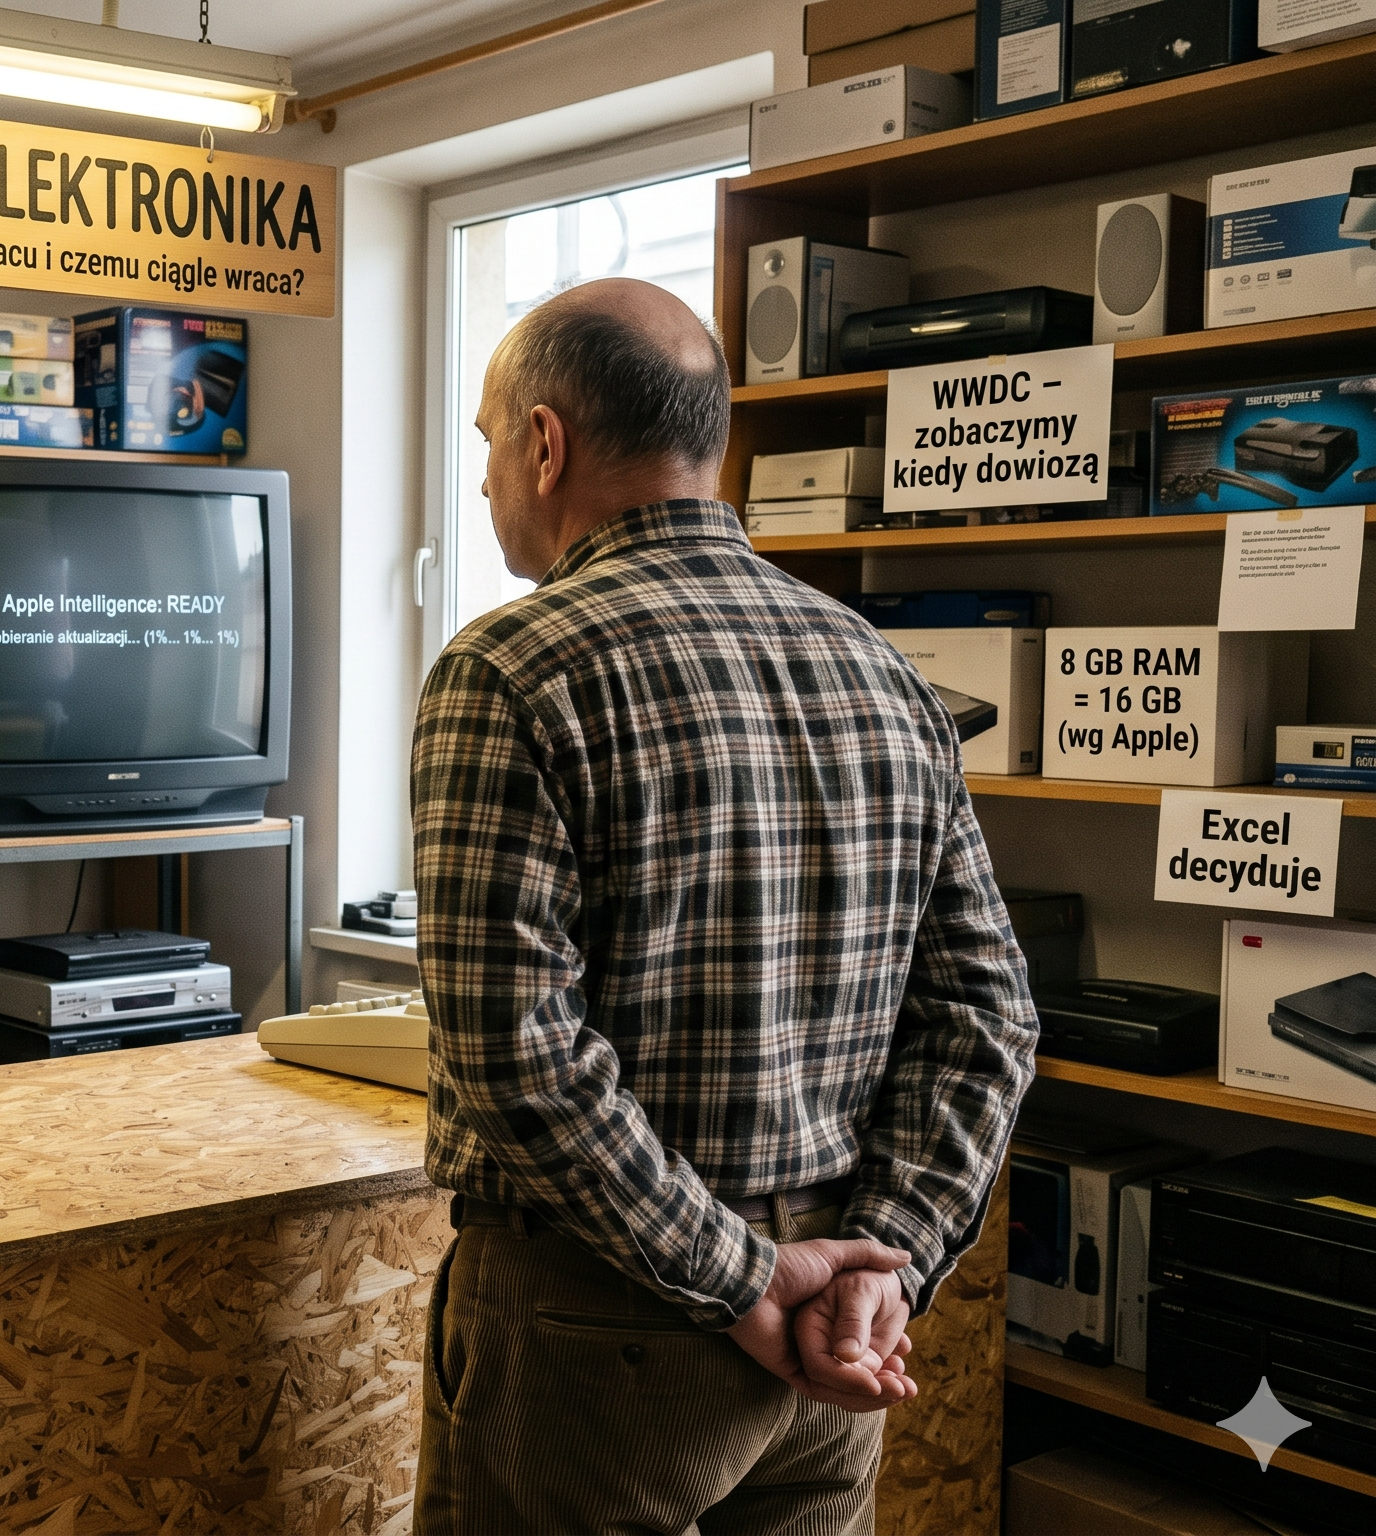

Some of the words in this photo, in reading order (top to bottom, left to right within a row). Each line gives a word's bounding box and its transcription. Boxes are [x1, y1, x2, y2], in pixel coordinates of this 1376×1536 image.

[45, 241, 52, 271] i
[60, 250, 139, 280] czemu
[147, 253, 218, 293] ciągle
[224, 268, 305, 297] wraca?
[932, 370, 1031, 410] WWDC
[914, 413, 1078, 450] zobaczymy
[893, 455, 968, 494] kiedy
[976, 449, 1099, 484] dowiozą
[2, 593, 55, 618] Apple
[59, 593, 163, 618] Intelligence:
[167, 594, 226, 614] READY
[57, 629, 141, 648] aktualizacji...
[1060, 648, 1076, 676] 8
[1085, 647, 1123, 676] GB
[1133, 647, 1201, 676] RAM
[1099, 686, 1132, 714] 16
[1141, 685, 1182, 714] GB
[1058, 719, 1104, 756] (wg
[1111, 722, 1199, 759] Apple)
[1201, 808, 1291, 846] Excel
[1169, 847, 1322, 899] decyduje
